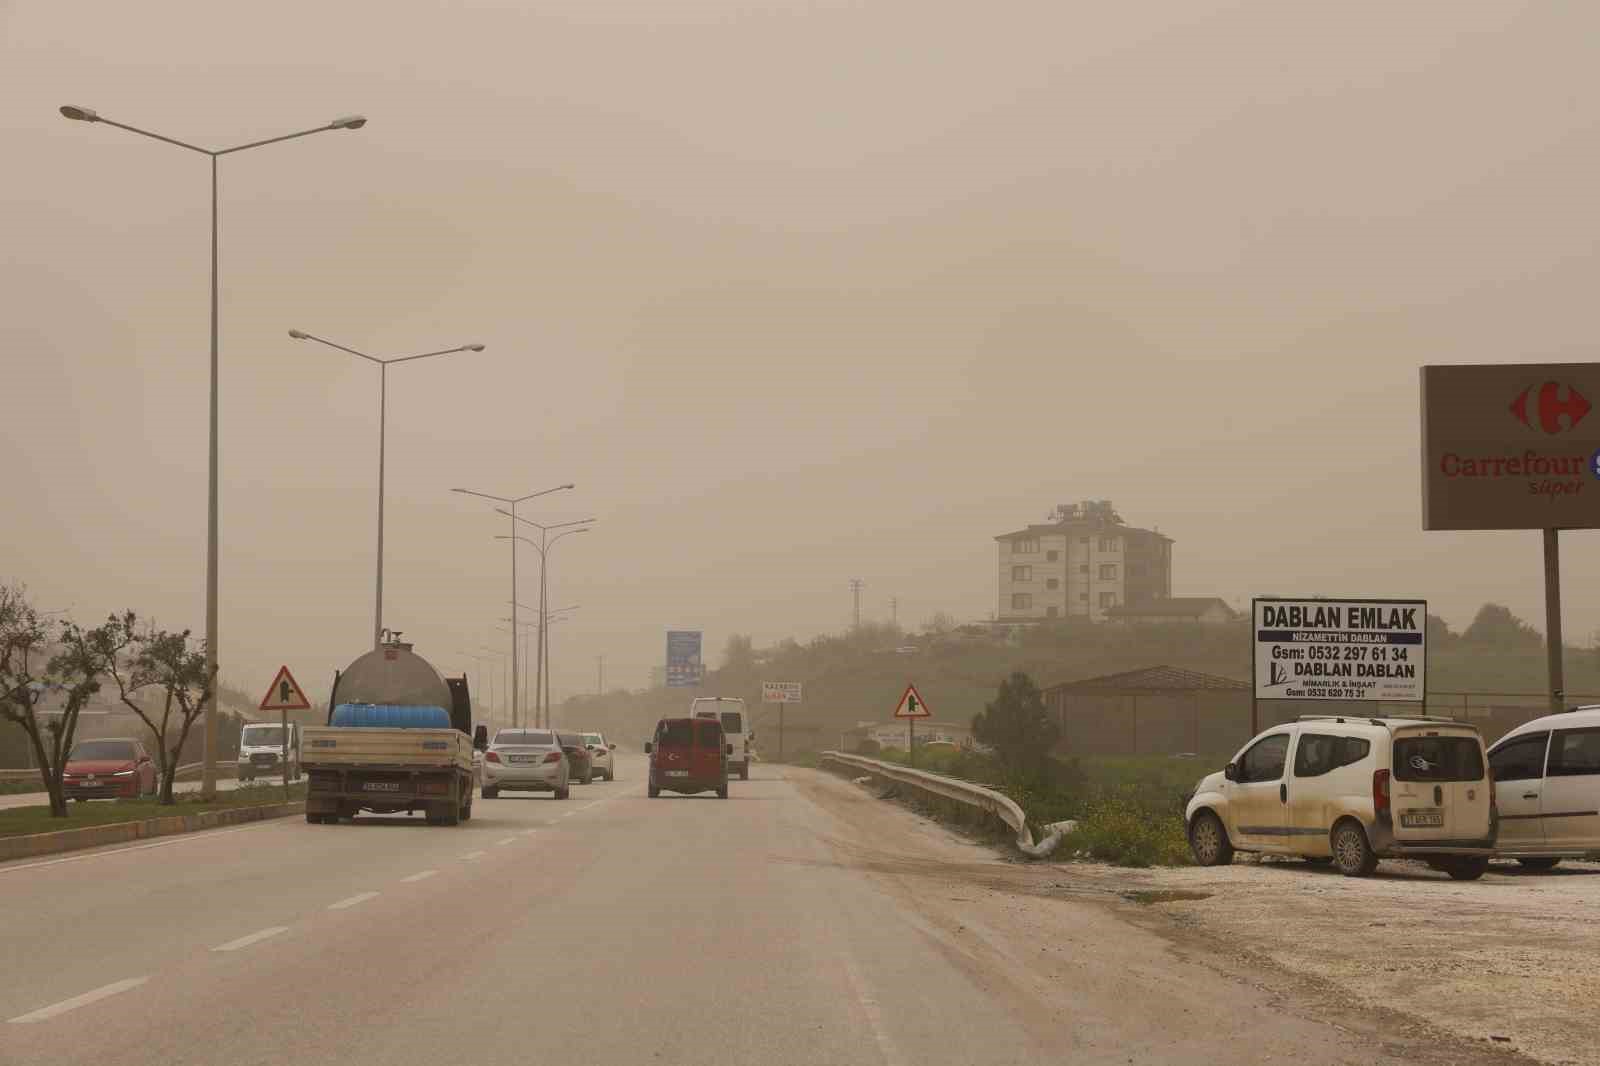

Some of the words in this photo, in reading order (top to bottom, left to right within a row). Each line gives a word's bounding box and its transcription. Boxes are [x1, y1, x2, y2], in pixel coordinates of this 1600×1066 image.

[1440, 451, 1584, 478] Carrefour
[1263, 605, 1341, 628] DABLAN
[1347, 607, 1417, 630] EMLAK
[1350, 633, 1388, 643] DABLAN
[1271, 645, 1305, 660] Gsm:
[1308, 646, 1340, 660] 0532
[1343, 646, 1368, 661] 297
[1372, 647, 1387, 661] 61
[1391, 647, 1408, 662] 34
[1294, 662, 1351, 676] DABLAN
[1356, 663, 1415, 678] DABLAN
[1286, 688, 1306, 697] Gsm:
